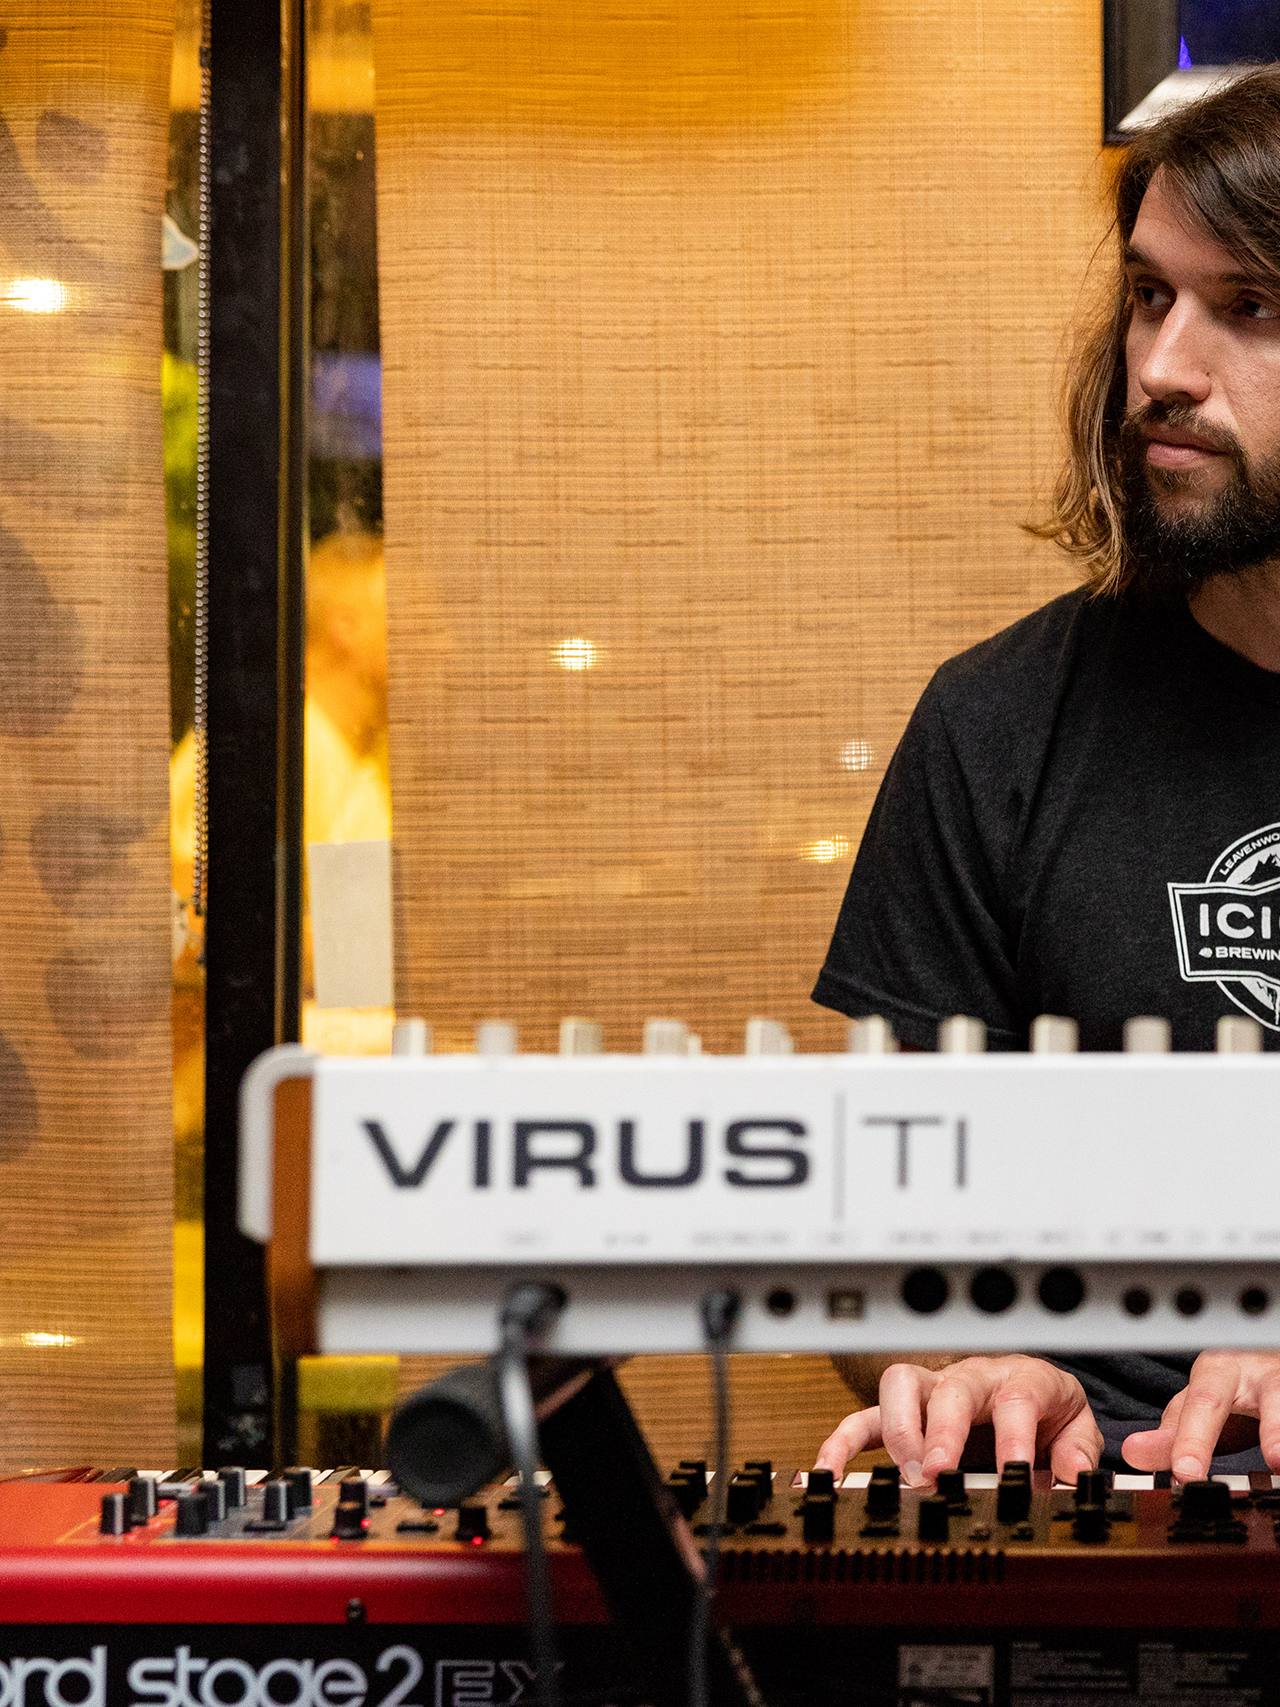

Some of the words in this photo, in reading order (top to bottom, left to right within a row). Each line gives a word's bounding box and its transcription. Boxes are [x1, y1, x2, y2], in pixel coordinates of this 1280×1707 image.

[361, 1117, 812, 1190] VIRUS
[861, 1114, 969, 1190] TI
[0, 1645, 108, 1707] rd
